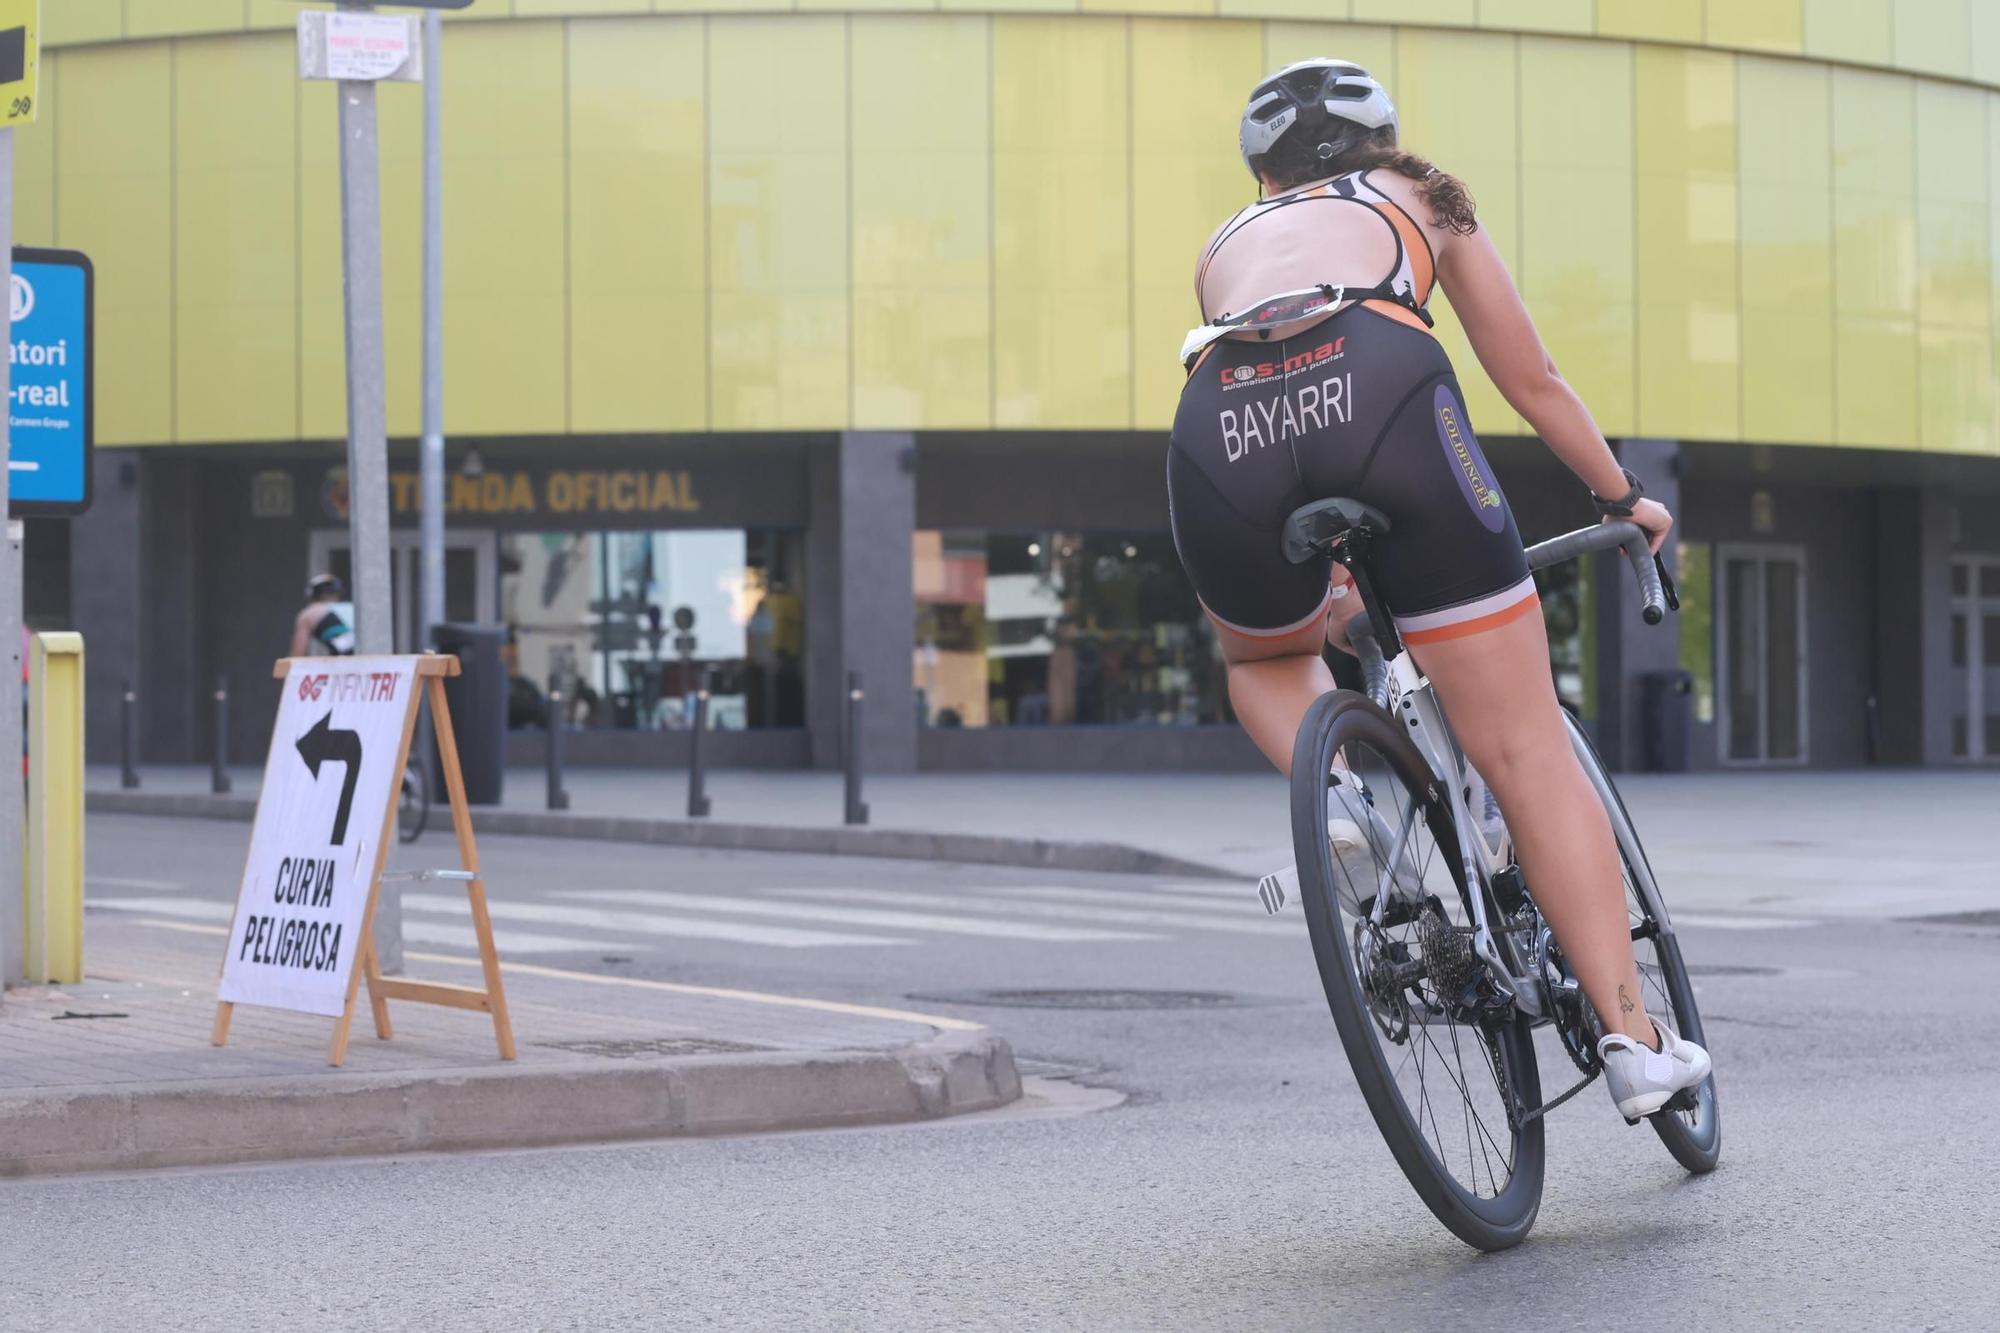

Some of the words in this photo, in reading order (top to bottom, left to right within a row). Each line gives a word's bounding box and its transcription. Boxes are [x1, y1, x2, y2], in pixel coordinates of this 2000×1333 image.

[1270, 115, 1286, 131] ELEO
[1285, 366, 1307, 379] para
[1309, 351, 1345, 371] puertas
[1220, 372, 1352, 463] BAYARRI
[1441, 405, 1492, 509] GOLDFINGER
[390, 472, 536, 513] TINDA
[547, 470, 700, 512] OFICIAL
[274, 857, 335, 908] CURVA
[240, 915, 342, 972] PELIGROSA
